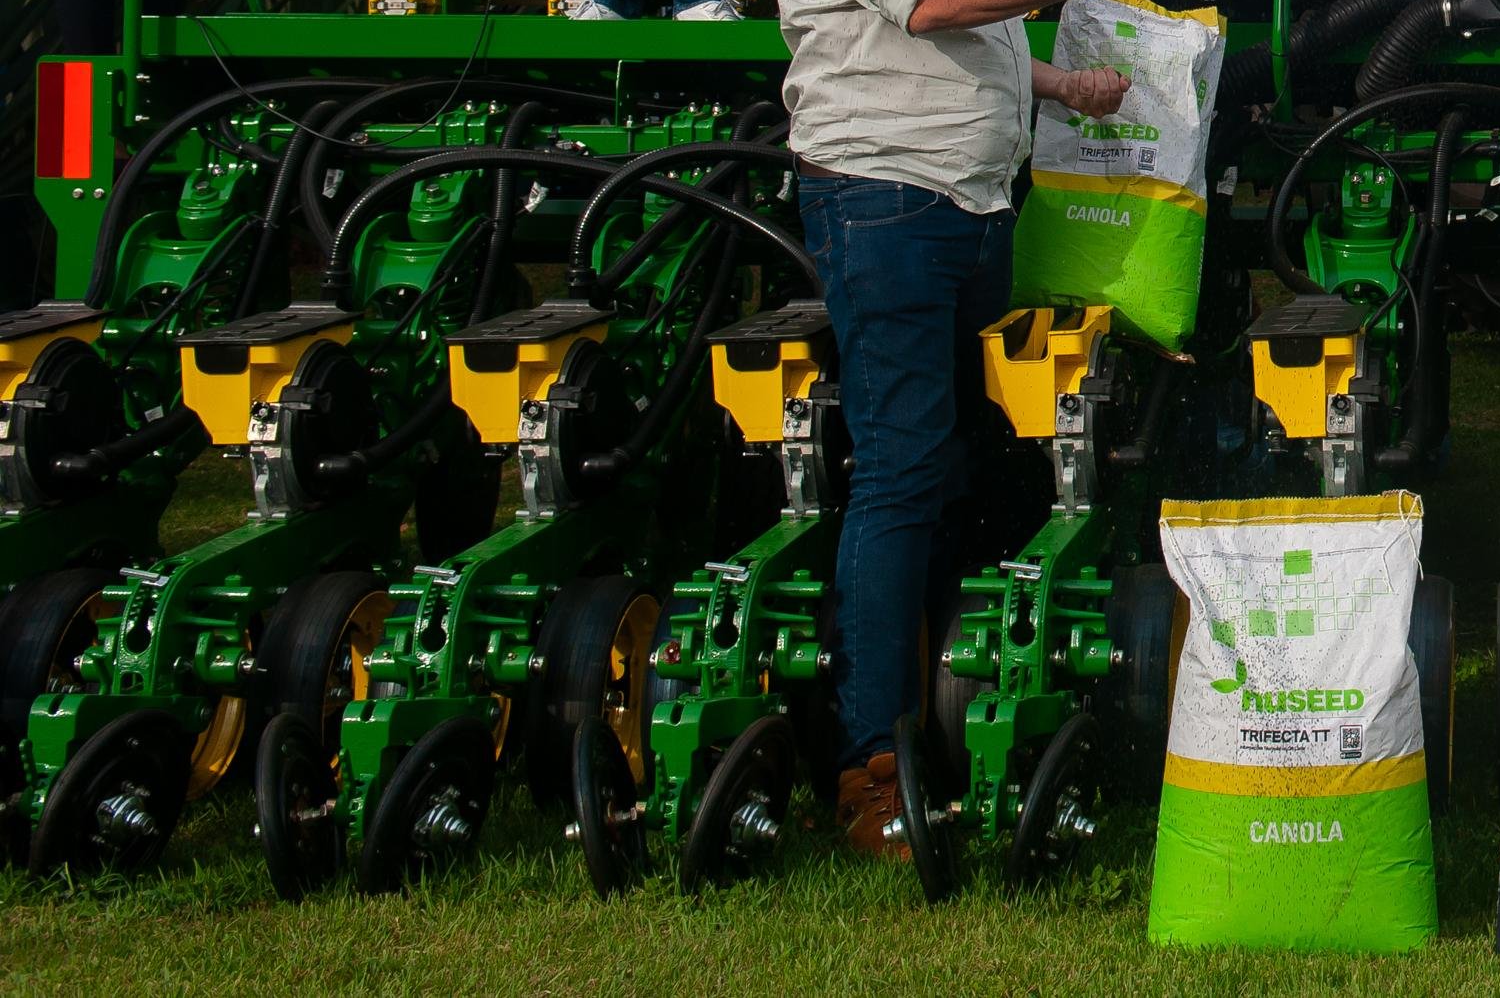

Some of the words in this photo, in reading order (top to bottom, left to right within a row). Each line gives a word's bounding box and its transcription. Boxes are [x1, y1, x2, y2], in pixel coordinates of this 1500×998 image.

[1066, 204, 1131, 227] CANOLA
[1240, 729, 1310, 743] TRIFECTA
[1311, 729, 1331, 742] TT
[1249, 821, 1344, 844] CANOLA
